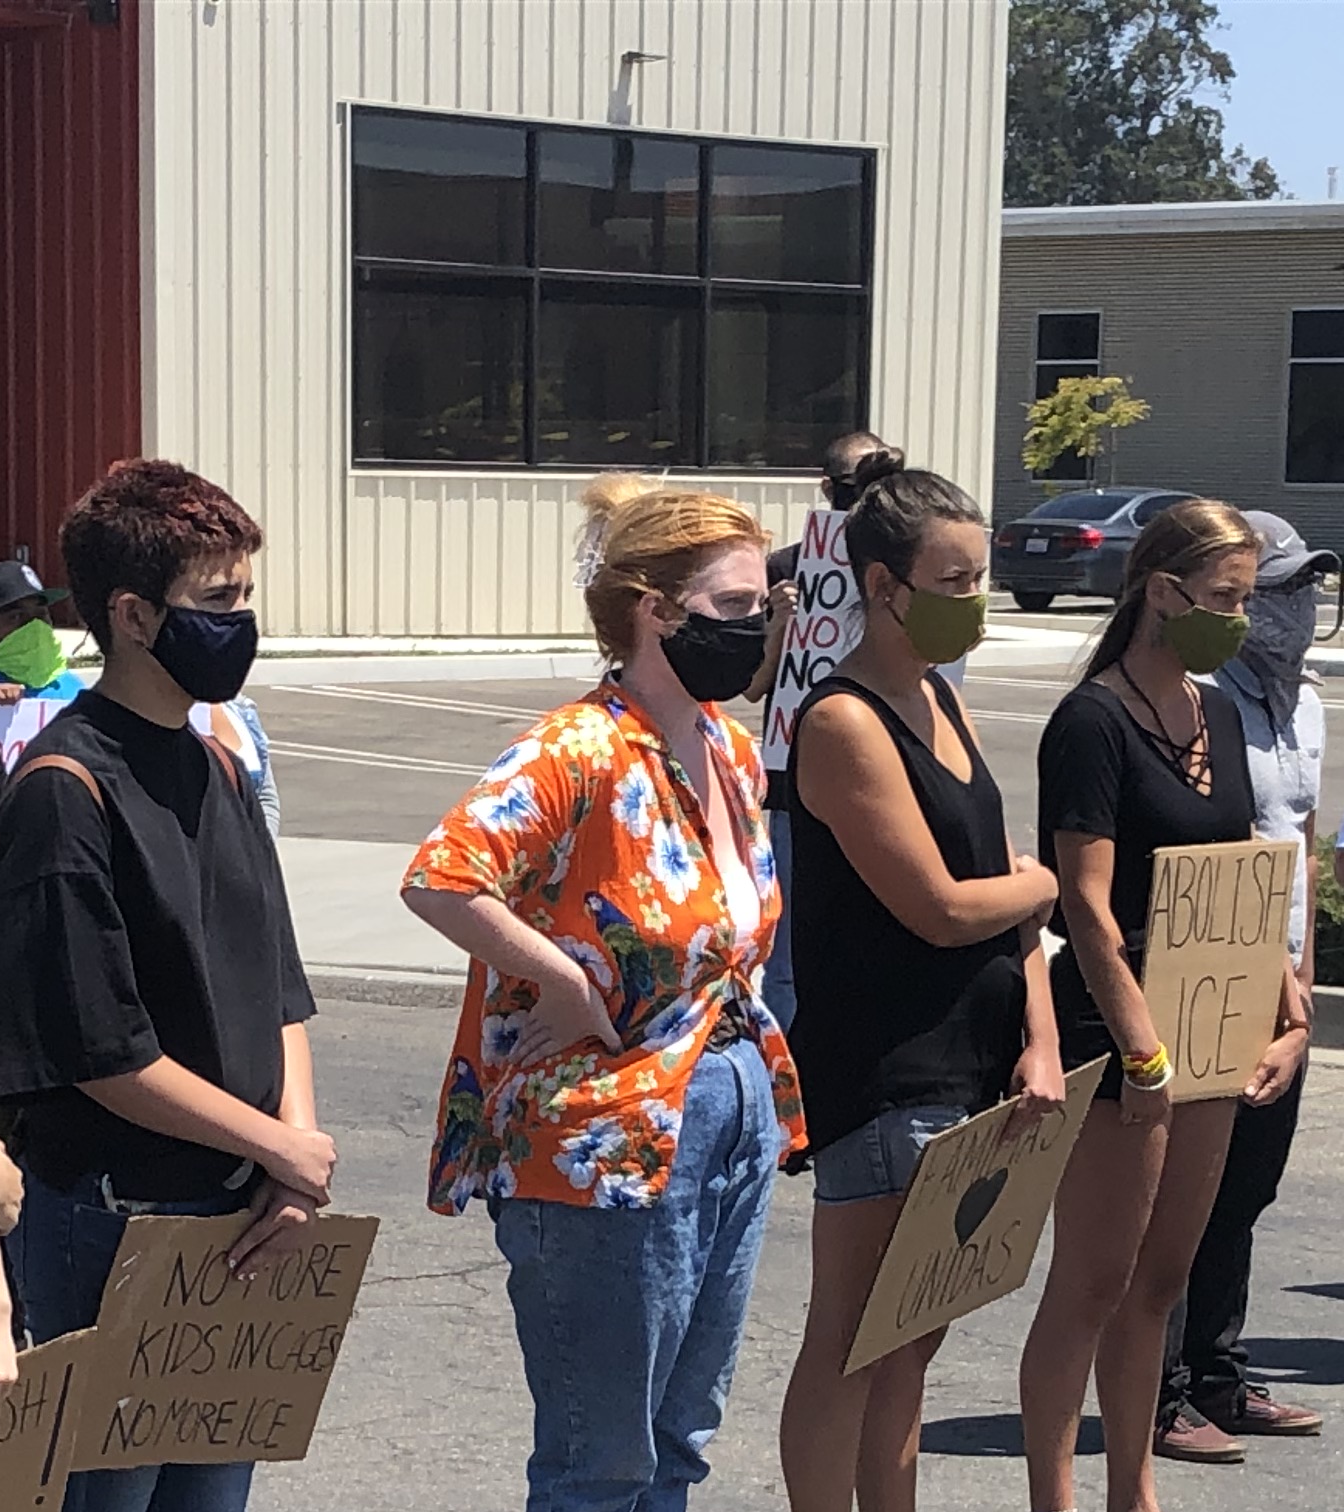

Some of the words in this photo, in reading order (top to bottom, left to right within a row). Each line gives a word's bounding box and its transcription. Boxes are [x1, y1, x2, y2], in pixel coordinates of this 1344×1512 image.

[798, 569, 847, 614] NO
[787, 615, 839, 650] NO
[780, 650, 836, 691] NO
[769, 706, 798, 746] N
[1149, 850, 1293, 949] ABOLISH
[1174, 975, 1248, 1080] ICE
[163, 1244, 231, 1307] NO
[896, 1220, 1021, 1329] UNIDAS
[129, 1320, 223, 1380] KIDS
[228, 1320, 273, 1370] IN
[102, 1398, 156, 1455] NO
[154, 1397, 237, 1447] MORE
[237, 1397, 294, 1449] ICE
